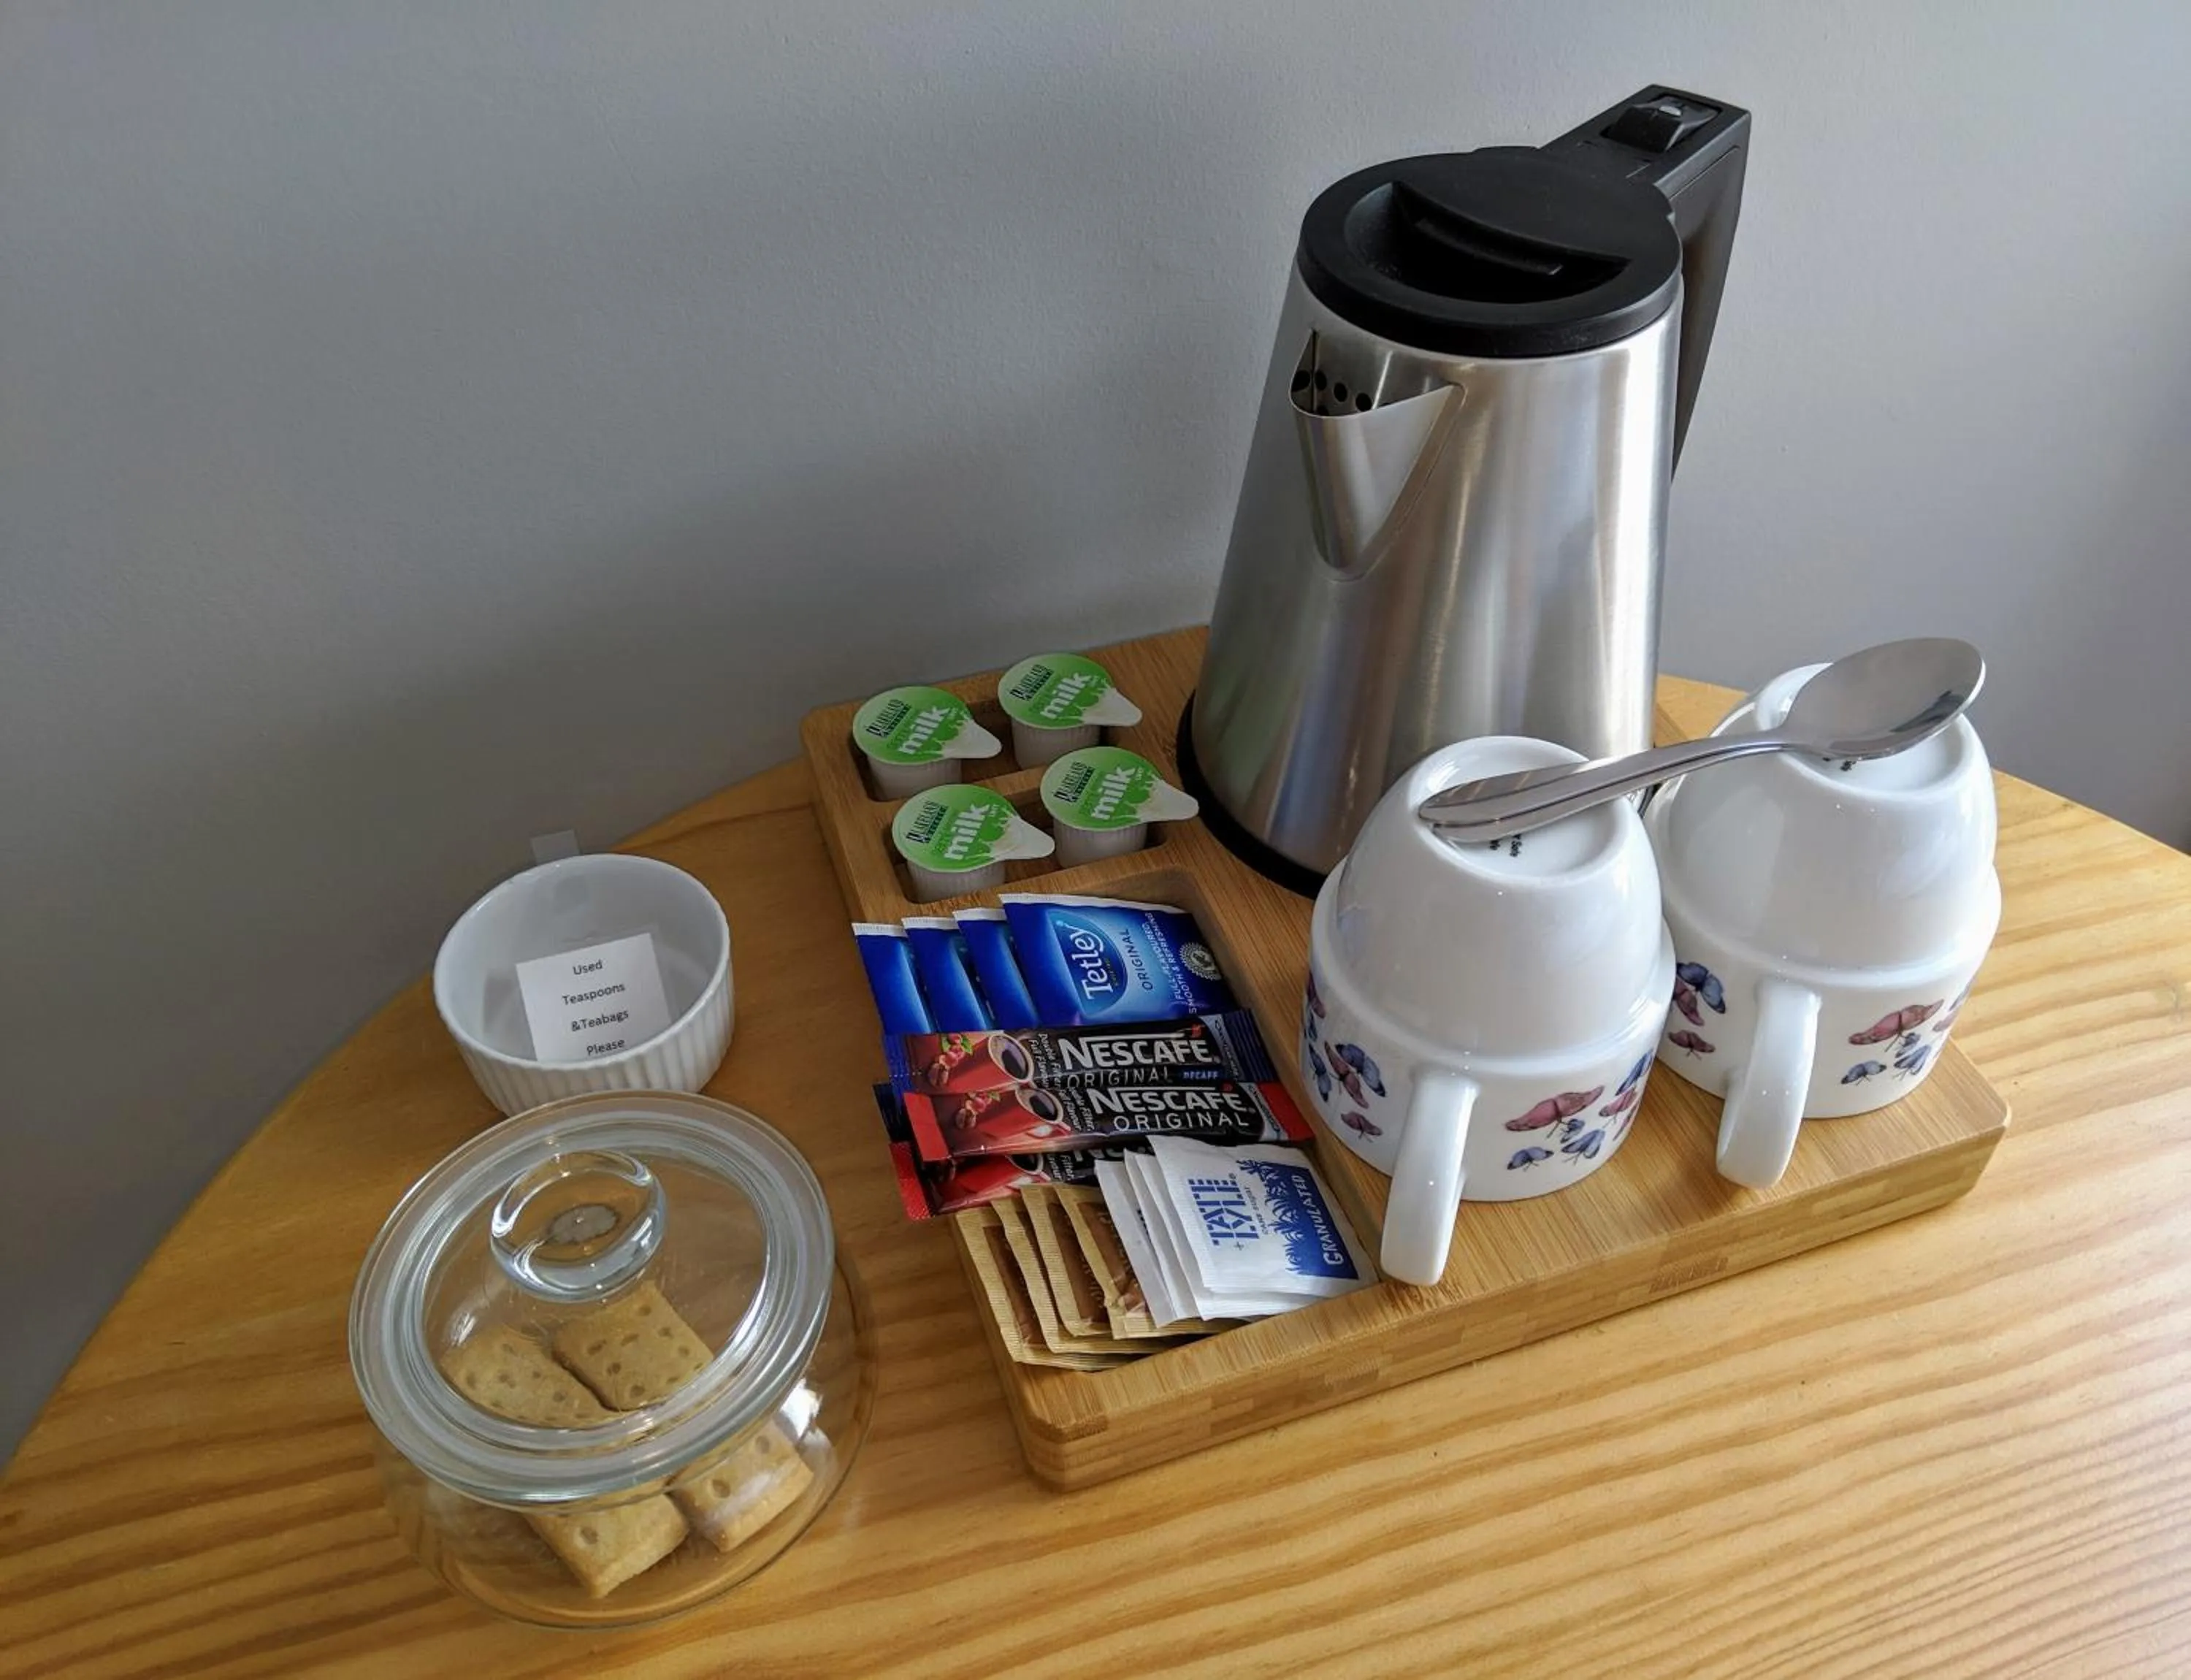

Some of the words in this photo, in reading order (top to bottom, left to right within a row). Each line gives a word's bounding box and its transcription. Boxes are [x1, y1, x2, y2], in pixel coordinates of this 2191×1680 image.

[1040, 672, 1091, 719] milk
[898, 706, 951, 755] milk
[1091, 766, 1136, 820] milk
[944, 803, 991, 860] milk
[573, 959, 603, 976] Used
[1060, 922, 1114, 1000] Tetley
[1119, 928, 1153, 992] ORIGINAL
[562, 982, 626, 1006] Teaspoons
[586, 1038, 626, 1057] Please
[1114, 1111, 1249, 1131] ORIGINAL
[1188, 1179, 1234, 1245] TATE
[1215, 1180, 1259, 1240] LYLE
[1291, 1175, 1345, 1265] GRANULATED
